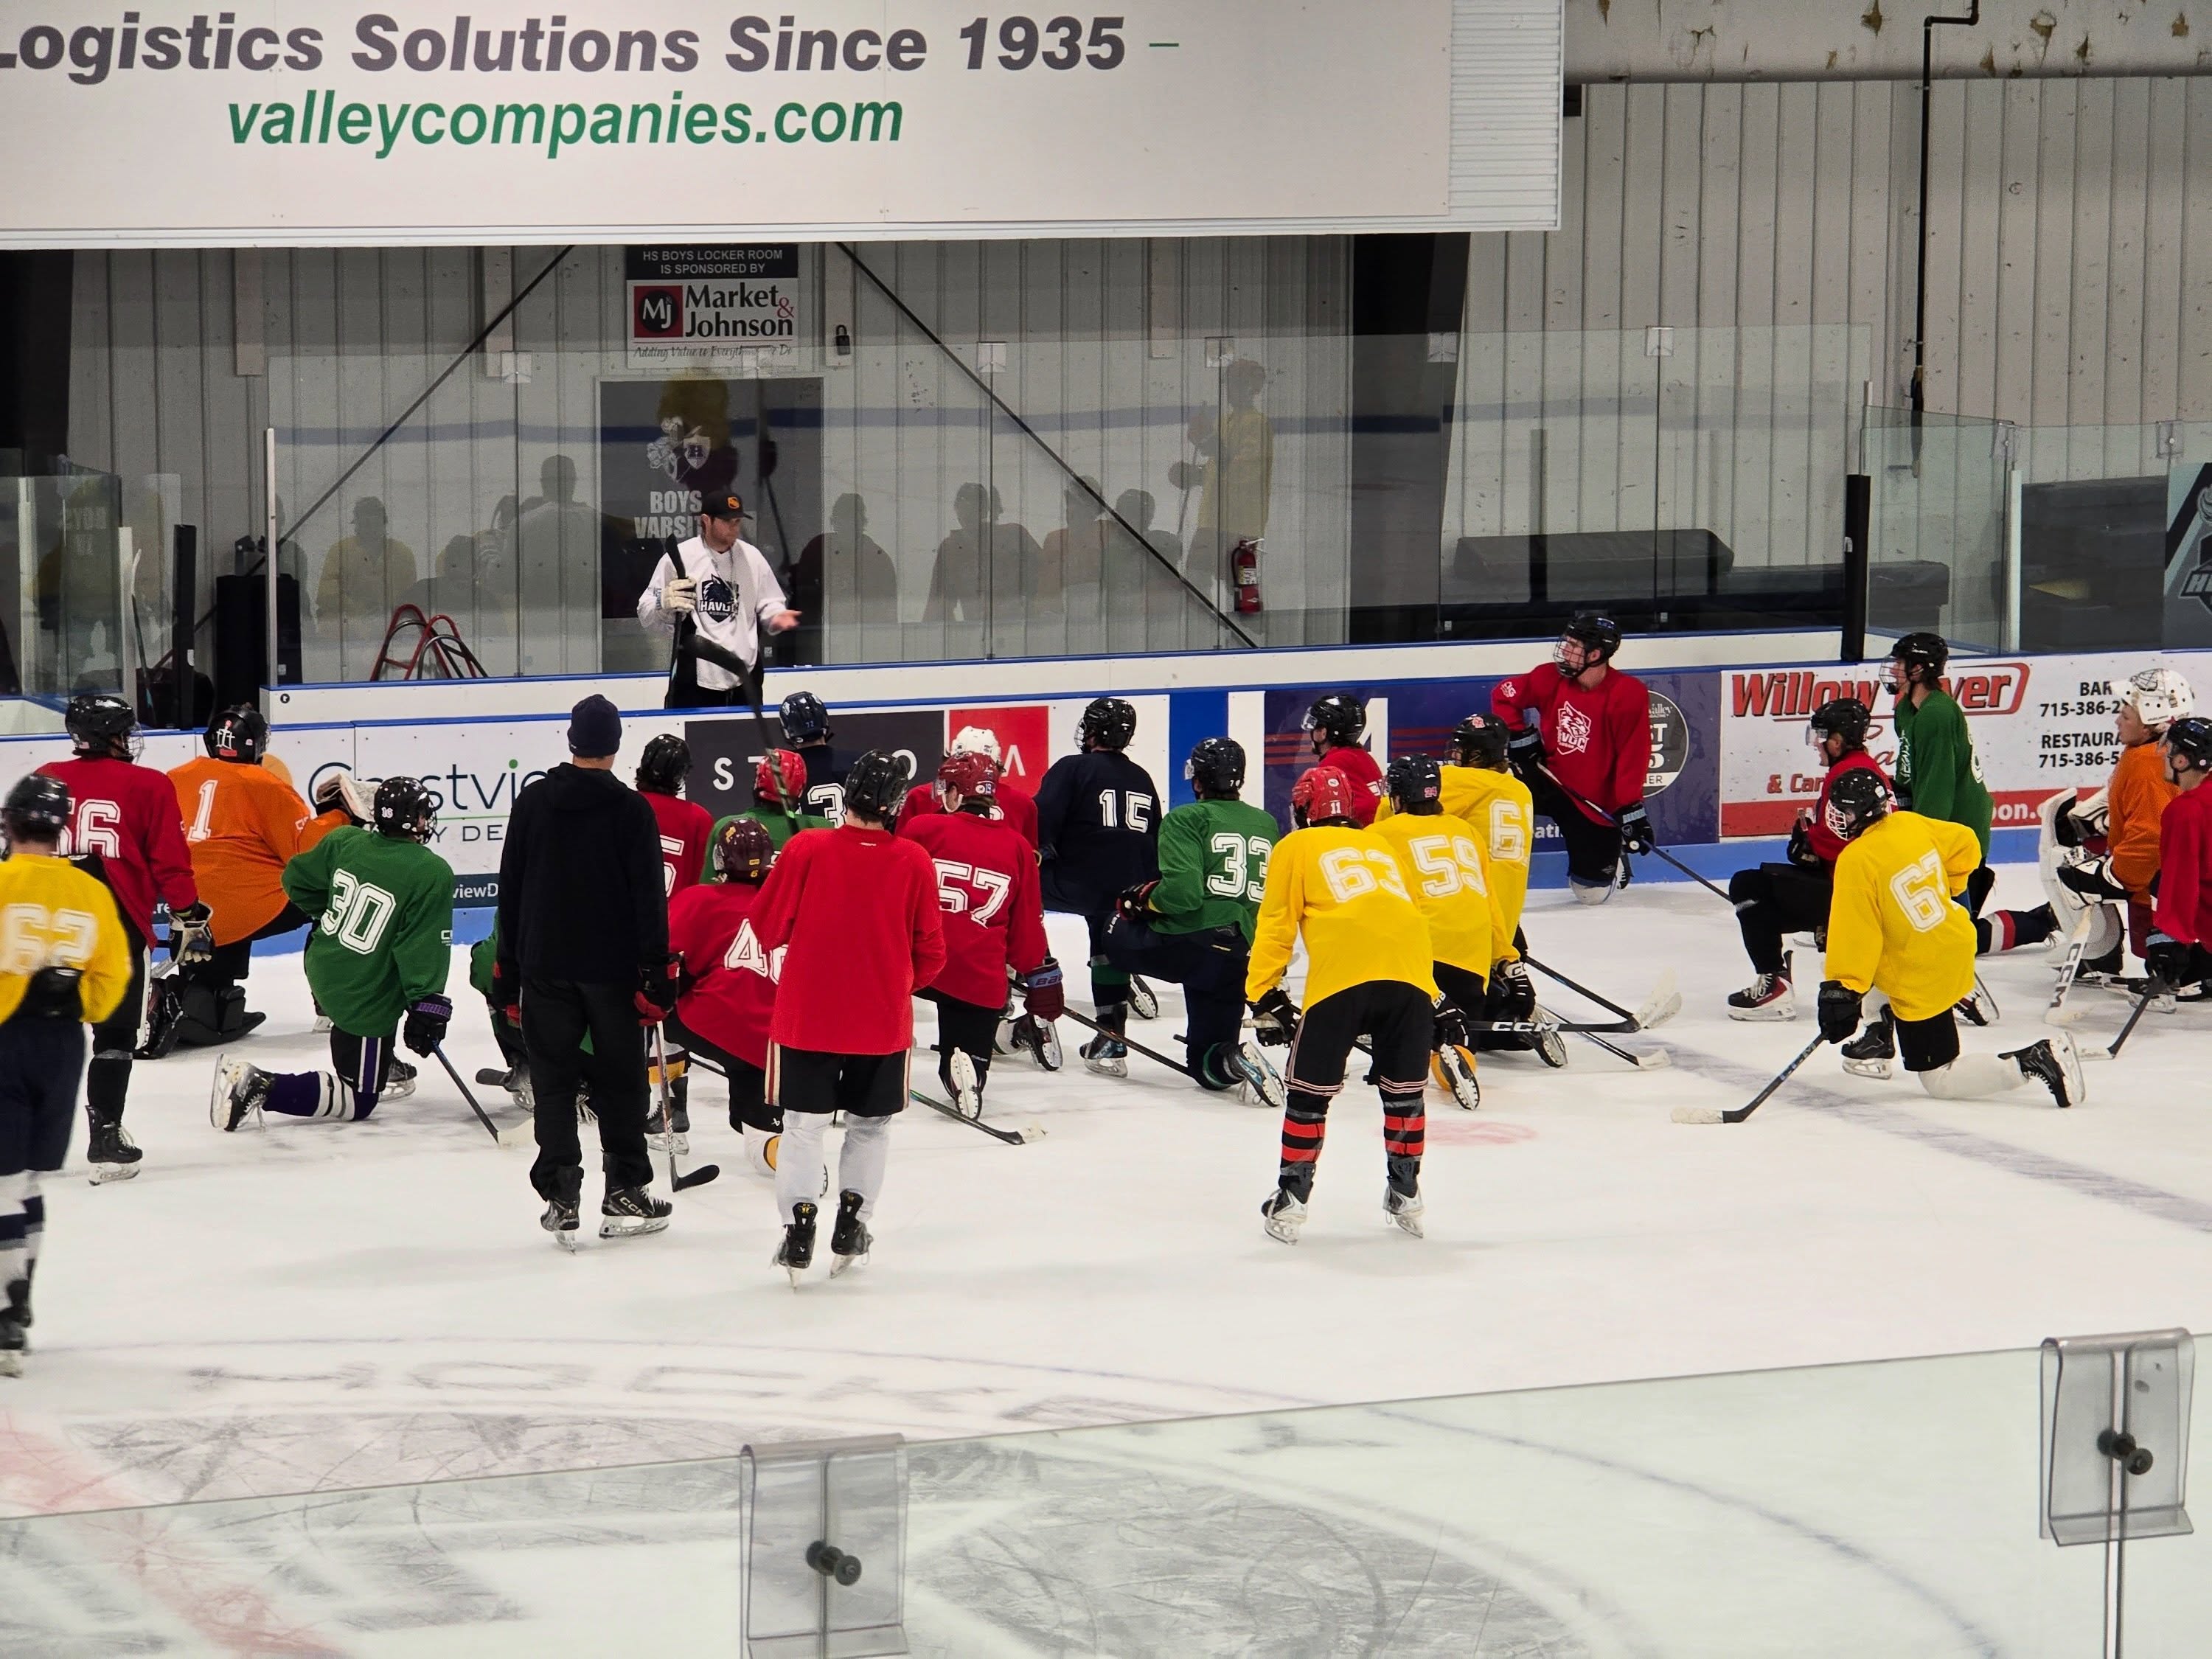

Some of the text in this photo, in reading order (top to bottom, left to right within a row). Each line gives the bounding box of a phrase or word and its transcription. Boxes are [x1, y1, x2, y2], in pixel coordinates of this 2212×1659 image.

[351, 13, 699, 72] Solutions
[726, 15, 927, 72] Since
[959, 16, 1126, 71] 1935
[229, 89, 904, 159] valleycompanies.com
[643, 249, 783, 261] HS BOYS LOCKER ROOM
[661, 263, 765, 274] IS SPONSORED BY
[685, 282, 795, 319] Market &
[684, 311, 793, 338] Johnson
[650, 490, 702, 514] BOYS
[634, 515, 702, 539] VARSIT
[2080, 681, 2113, 697] BAR
[2040, 700, 2121, 717] 715-386-2
[2042, 732, 2123, 748] RESTAURA
[2039, 751, 2119, 768] 715-386-5
[1767, 774, 1782, 793] &
[187, 779, 219, 843] 1
[1099, 788, 1152, 834] 15
[1207, 832, 1273, 902] 33
[1318, 846, 1413, 905] 63
[932, 858, 1012, 928] 57
[1889, 847, 1949, 933] 67
[320, 868, 397, 956] 30
[1491, 1021, 1562, 1032] CCM
